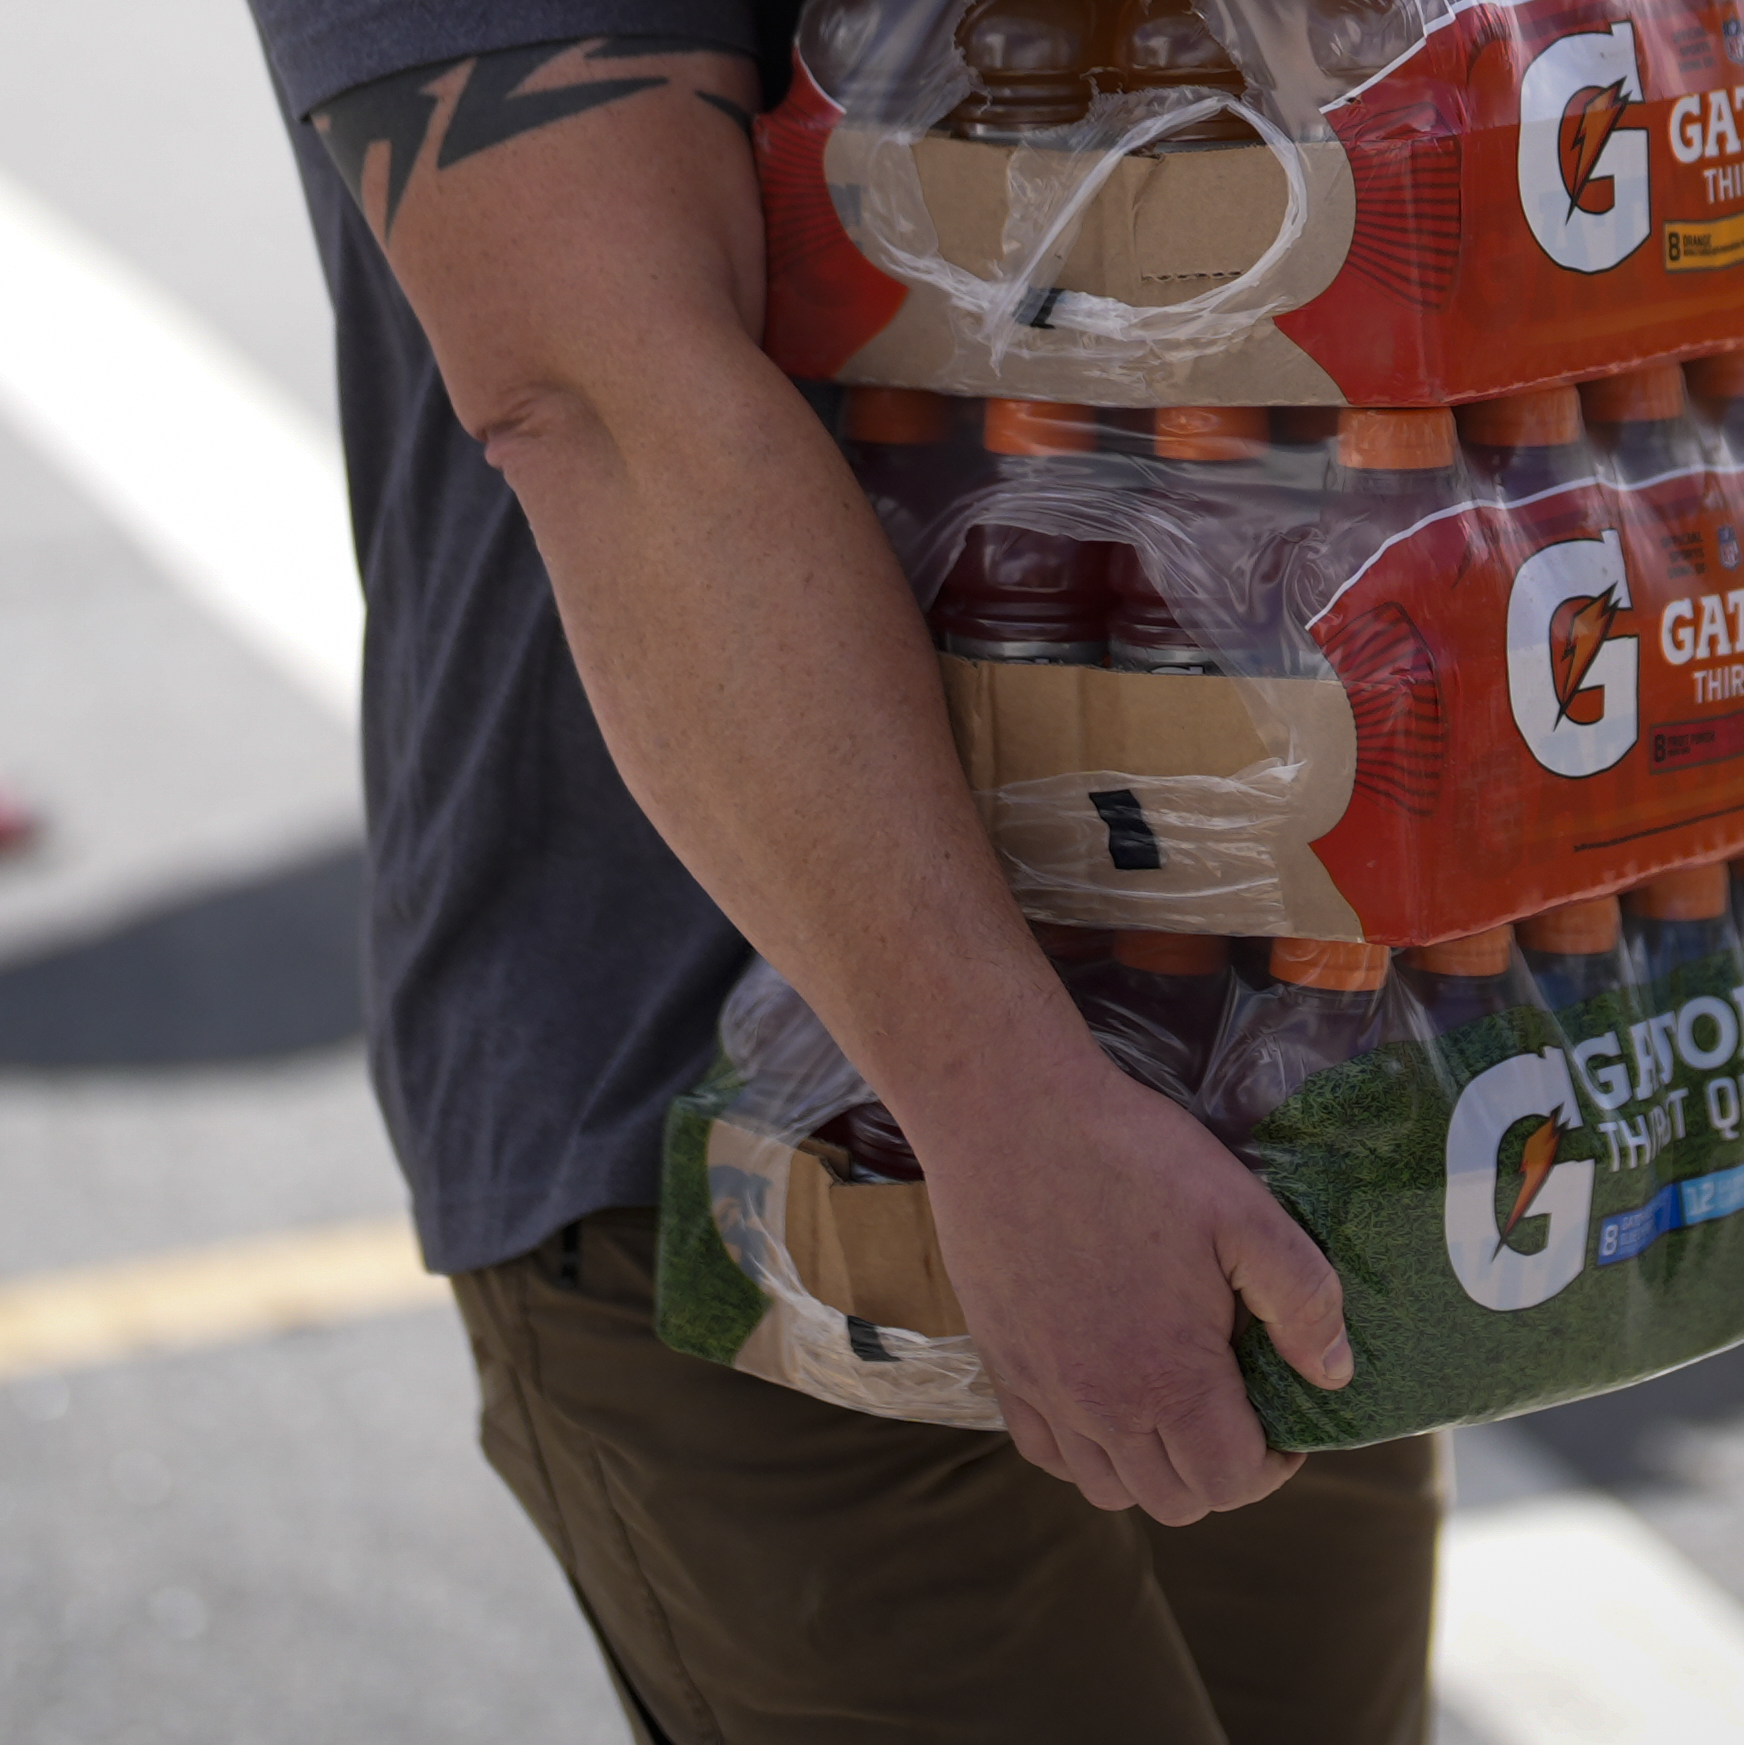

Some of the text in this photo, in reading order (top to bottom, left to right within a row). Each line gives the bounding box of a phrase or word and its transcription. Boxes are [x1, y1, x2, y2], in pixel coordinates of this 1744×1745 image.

[1517, 20, 1651, 274] G
[1668, 232, 1681, 262] 8
[1682, 232, 1713, 248] ORANGE
[1506, 528, 1640, 778] G
[1654, 733, 1667, 764] 8
[1444, 1046, 1595, 1312] G
[1602, 1224, 1619, 1256] 8
